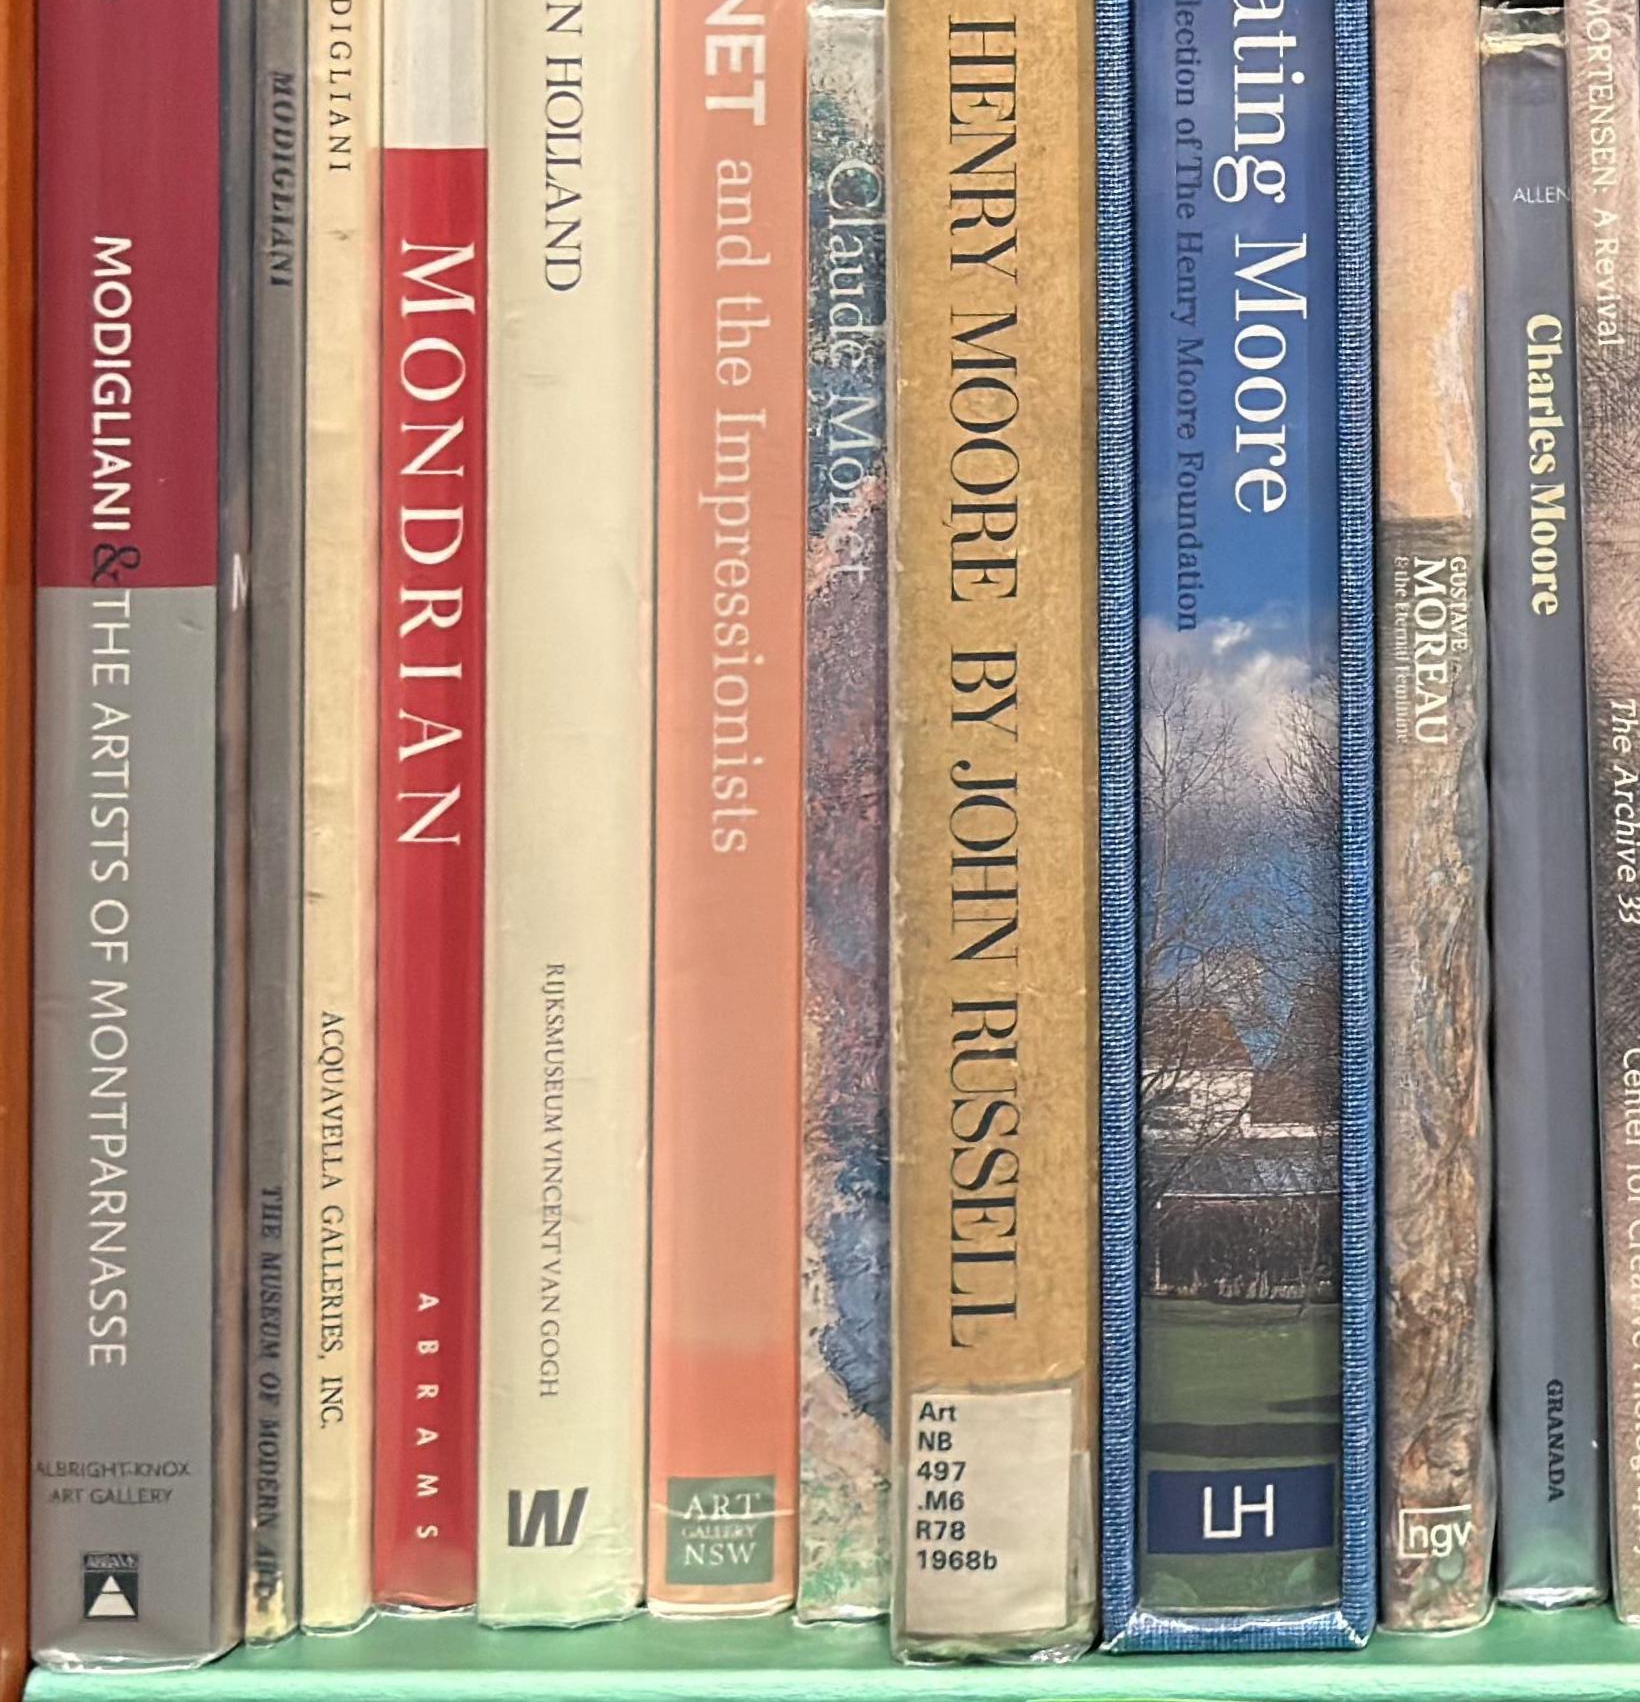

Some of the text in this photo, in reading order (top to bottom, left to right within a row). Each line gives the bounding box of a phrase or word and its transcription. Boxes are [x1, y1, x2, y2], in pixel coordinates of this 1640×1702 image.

[543, 55, 584, 294] HOLLAND
[1172, 116, 1203, 149] of
[267, 70, 297, 289] MODIGLIANI
[713, 157, 770, 270] and
[1173, 153, 1204, 220] The
[1512, 185, 1571, 204] ALLEN
[1593, 207, 1619, 229] A
[1167, 230, 1204, 326] Henry
[1594, 236, 1626, 346] Revival
[713, 295, 770, 387] the
[826, 158, 884, 580] Claude Monet
[1233, 232, 1309, 514] Moore
[1173, 337, 1203, 440] Moore
[1525, 313, 1566, 617] Charles Moore
[397, 239, 476, 845] MONDRIAN
[1174, 450, 1205, 633] Foundation
[1394, 570, 1411, 598] the
[700, 408, 768, 854] Impressionists
[1394, 601, 1411, 662] Eternal
[1448, 556, 1468, 652] GUSTAVE
[947, 14, 1020, 1350] HENRY MOORE BY JOHN RUSSELL
[1413, 556, 1448, 745] MOREAU
[1394, 666, 1411, 745] Feminine
[1610, 699, 1640, 754] The
[87, 235, 140, 1367] MODIGLIANI & THE ARTISTS OF MONTPARNASSE
[260, 1184, 281, 1239] THE
[316, 1011, 345, 1430] ACQUAVELLA GALLERIES, INC.
[537, 962, 567, 1398] RIJKSMUSEUM VINCENT VAN GOGH
[258, 1250, 281, 1361] MUSEUM
[257, 1371, 280, 1407] OF
[415, 1291, 440, 1540] ABRAMS
[918, 1401, 957, 1423] Art
[36, 1460, 191, 1478] ALBRIGHT-KNOX
[255, 1418, 280, 1529] MODERN
[916, 1460, 967, 1482] 497
[918, 1431, 953, 1451] NB
[1546, 1378, 1567, 1503] GRANADA
[50, 1488, 173, 1505] ART GALLERY
[681, 1523, 757, 1540] GALLERY
[684, 1493, 760, 1520] ART
[916, 1520, 966, 1541] R78
[917, 1490, 965, 1511] .M6
[1408, 1520, 1472, 1556] ngv
[684, 1542, 757, 1565] NSW
[916, 1550, 998, 1571] 1968b
